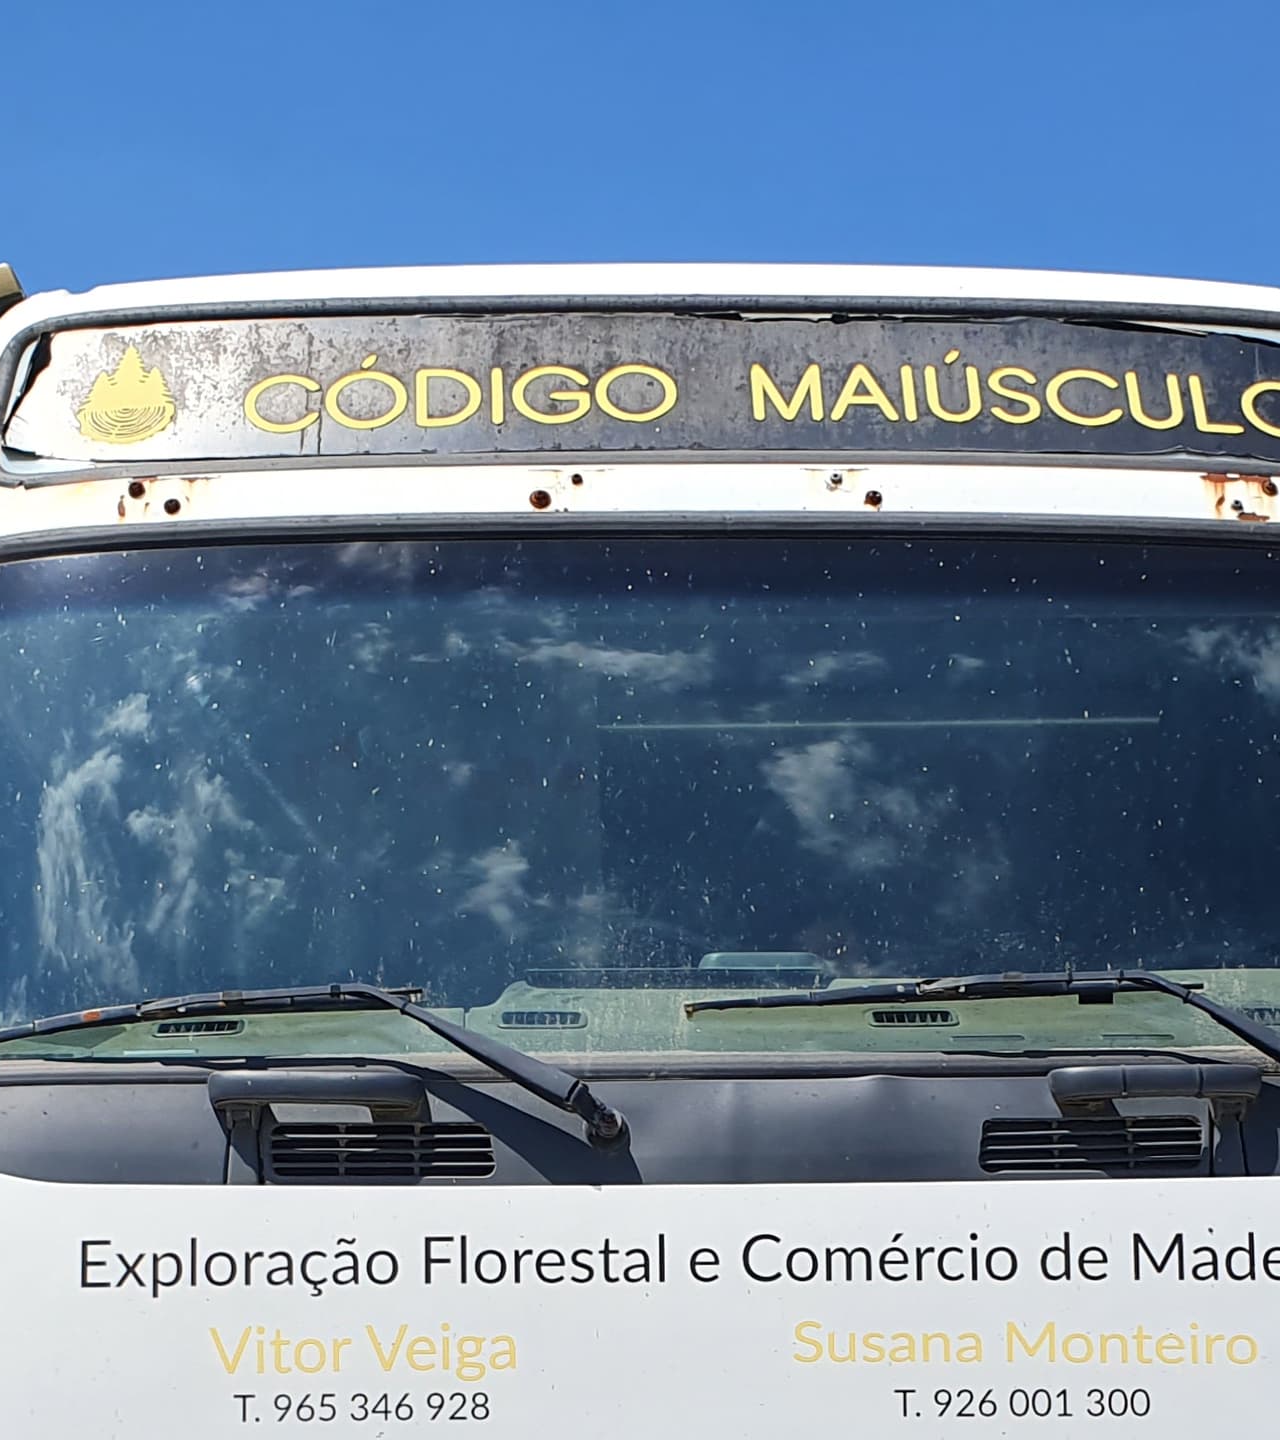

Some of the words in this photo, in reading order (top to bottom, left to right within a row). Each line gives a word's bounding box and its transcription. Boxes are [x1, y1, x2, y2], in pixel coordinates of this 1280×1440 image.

[243, 353, 678, 434] CÓDIGO
[80, 1237, 400, 1298] Exploração
[423, 1234, 667, 1285] Florestal
[687, 1249, 721, 1284] e
[741, 1232, 1019, 1284] Comércio
[1040, 1232, 1109, 1283] de
[209, 1324, 352, 1376] Vitor
[365, 1322, 518, 1382] Veiga
[792, 1320, 983, 1365] Susana
[1005, 1321, 1258, 1365] Monteiro
[233, 1394, 261, 1423] T.
[273, 1393, 338, 1423] 965
[349, 1392, 414, 1422] 346
[425, 1392, 491, 1422] 928
[894, 1389, 923, 1418] T.
[932, 1389, 998, 1418] 926
[1008, 1389, 1073, 1418] 001
[1085, 1389, 1151, 1418] 300
